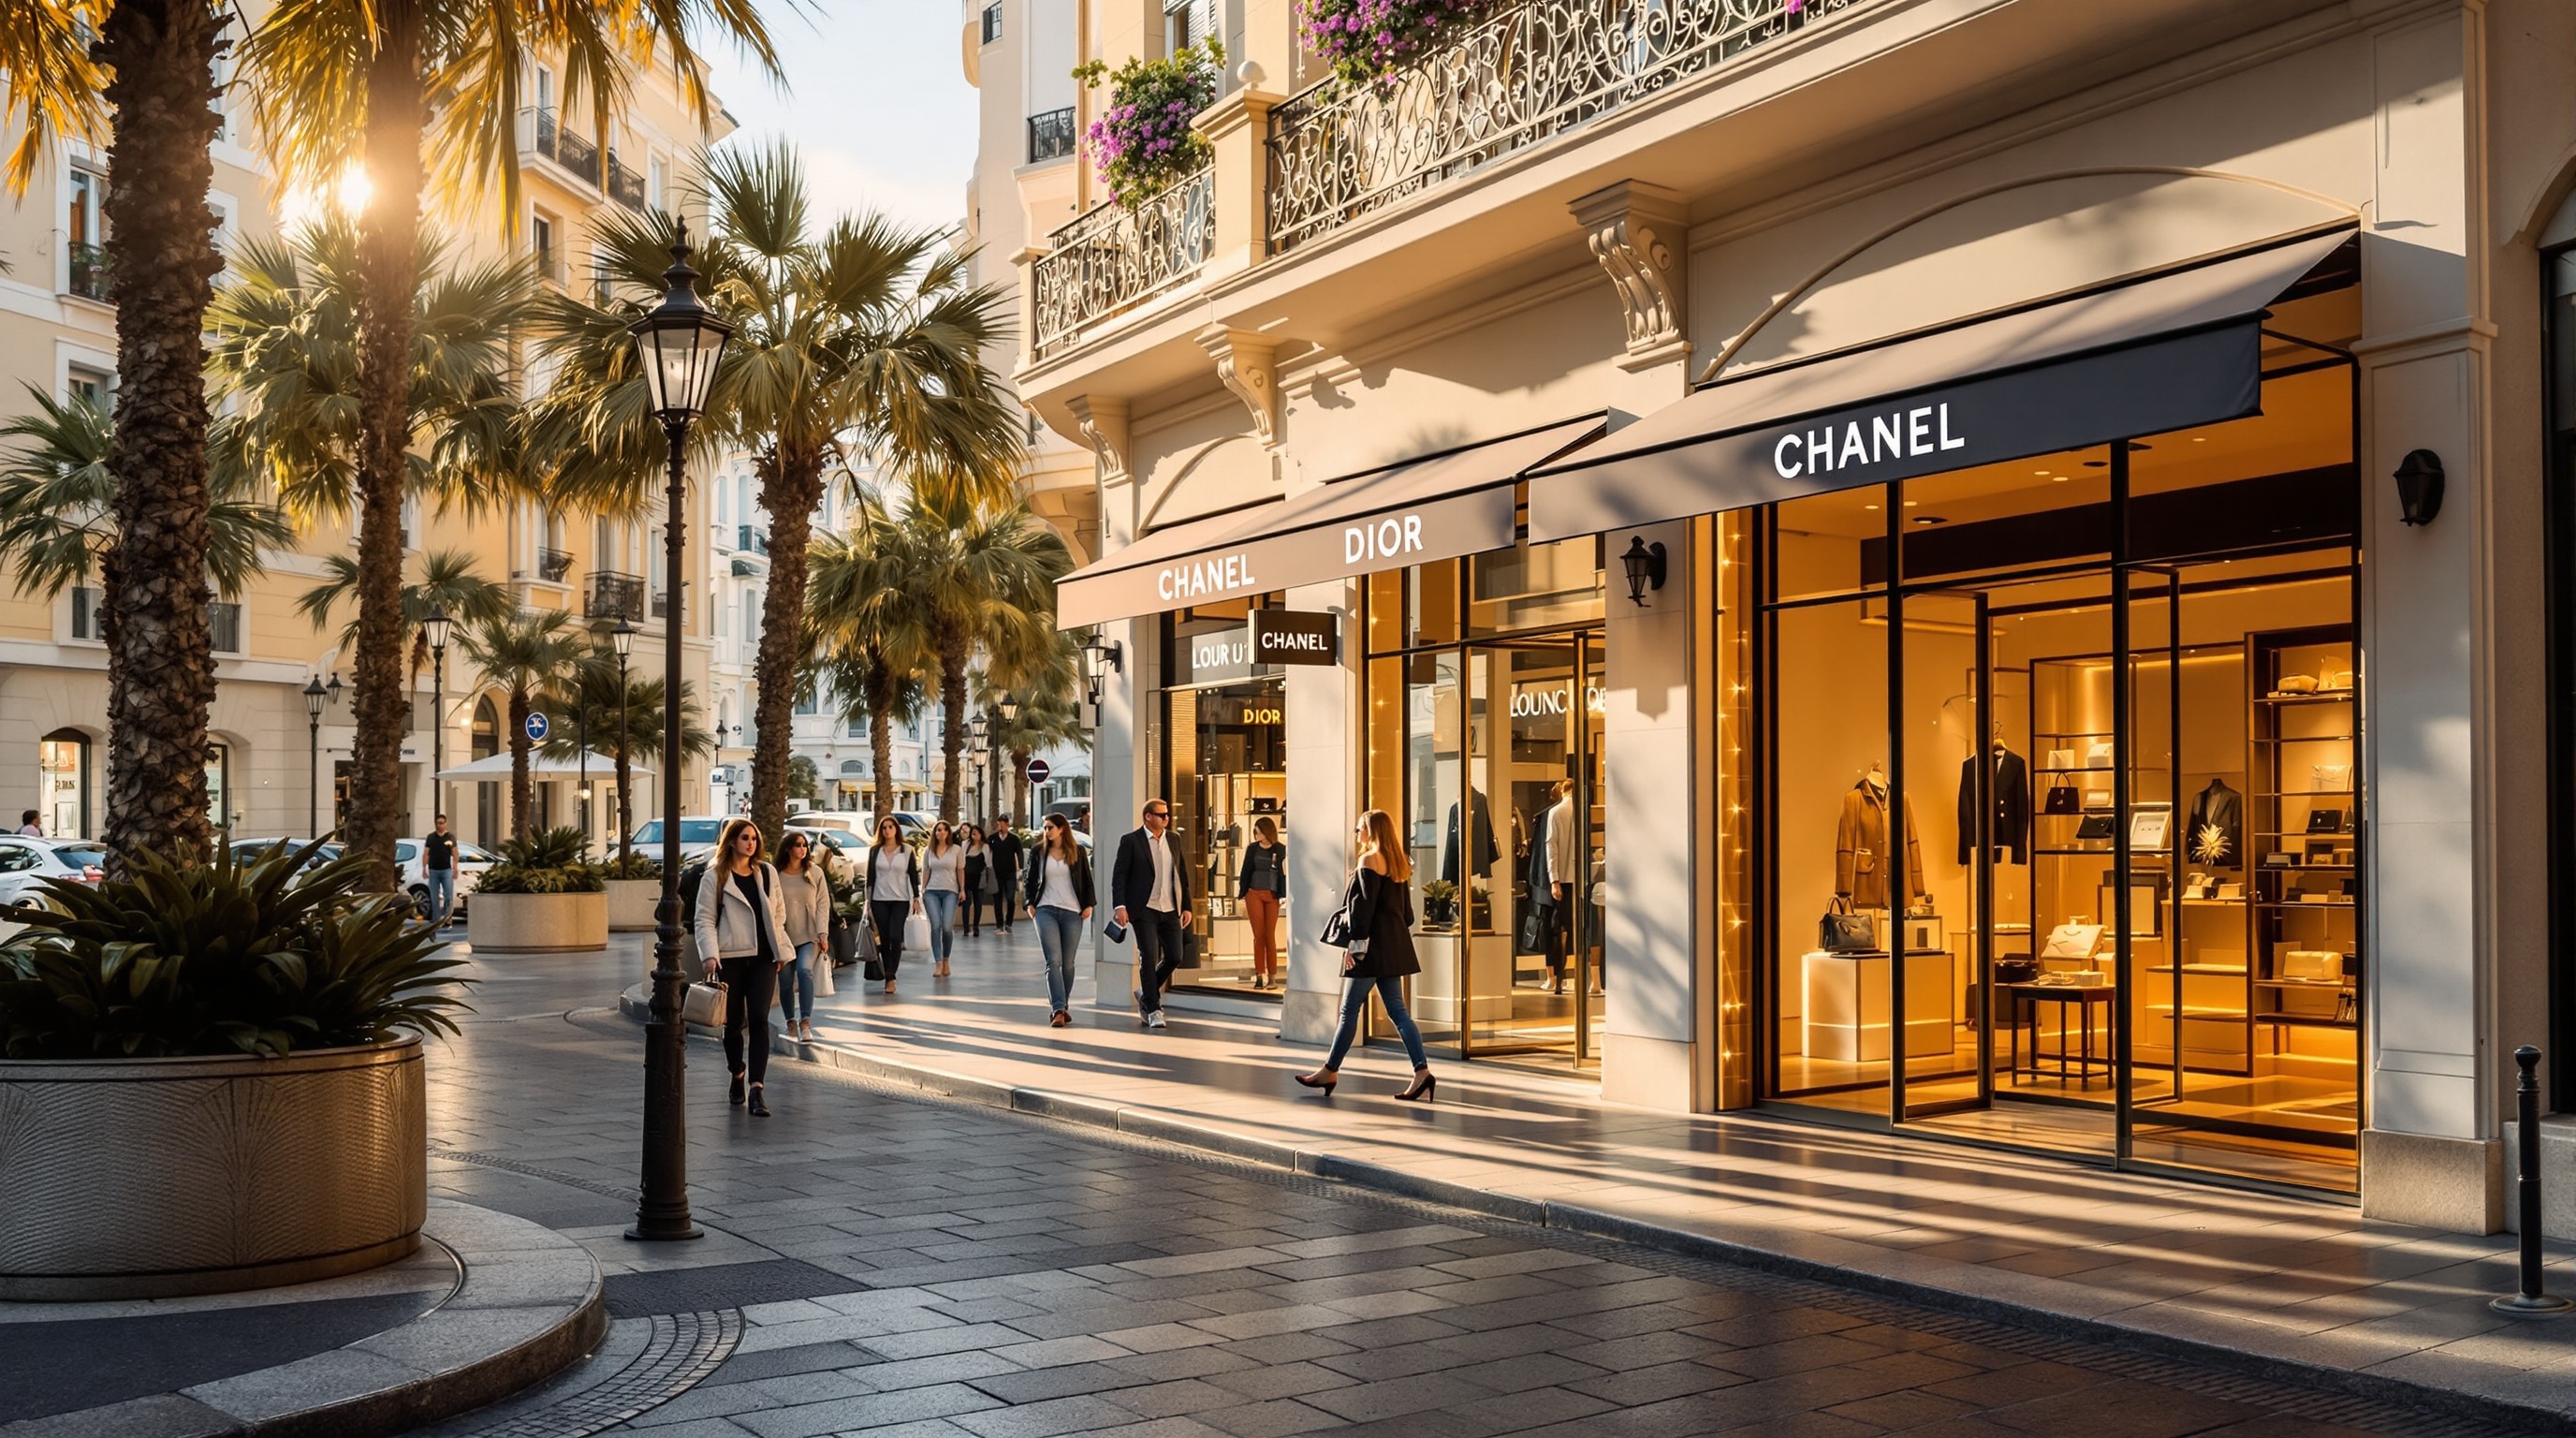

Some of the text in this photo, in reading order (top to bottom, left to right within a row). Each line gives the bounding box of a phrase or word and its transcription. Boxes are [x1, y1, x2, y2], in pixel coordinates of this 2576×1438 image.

[1774, 403, 1966, 479] CHANEL
[1158, 515, 1424, 601] CHANEL DIOR
[1261, 632, 1328, 651] CHANEL
[1192, 643, 1248, 669] LOUR U
[1243, 709, 1281, 725] DIOR
